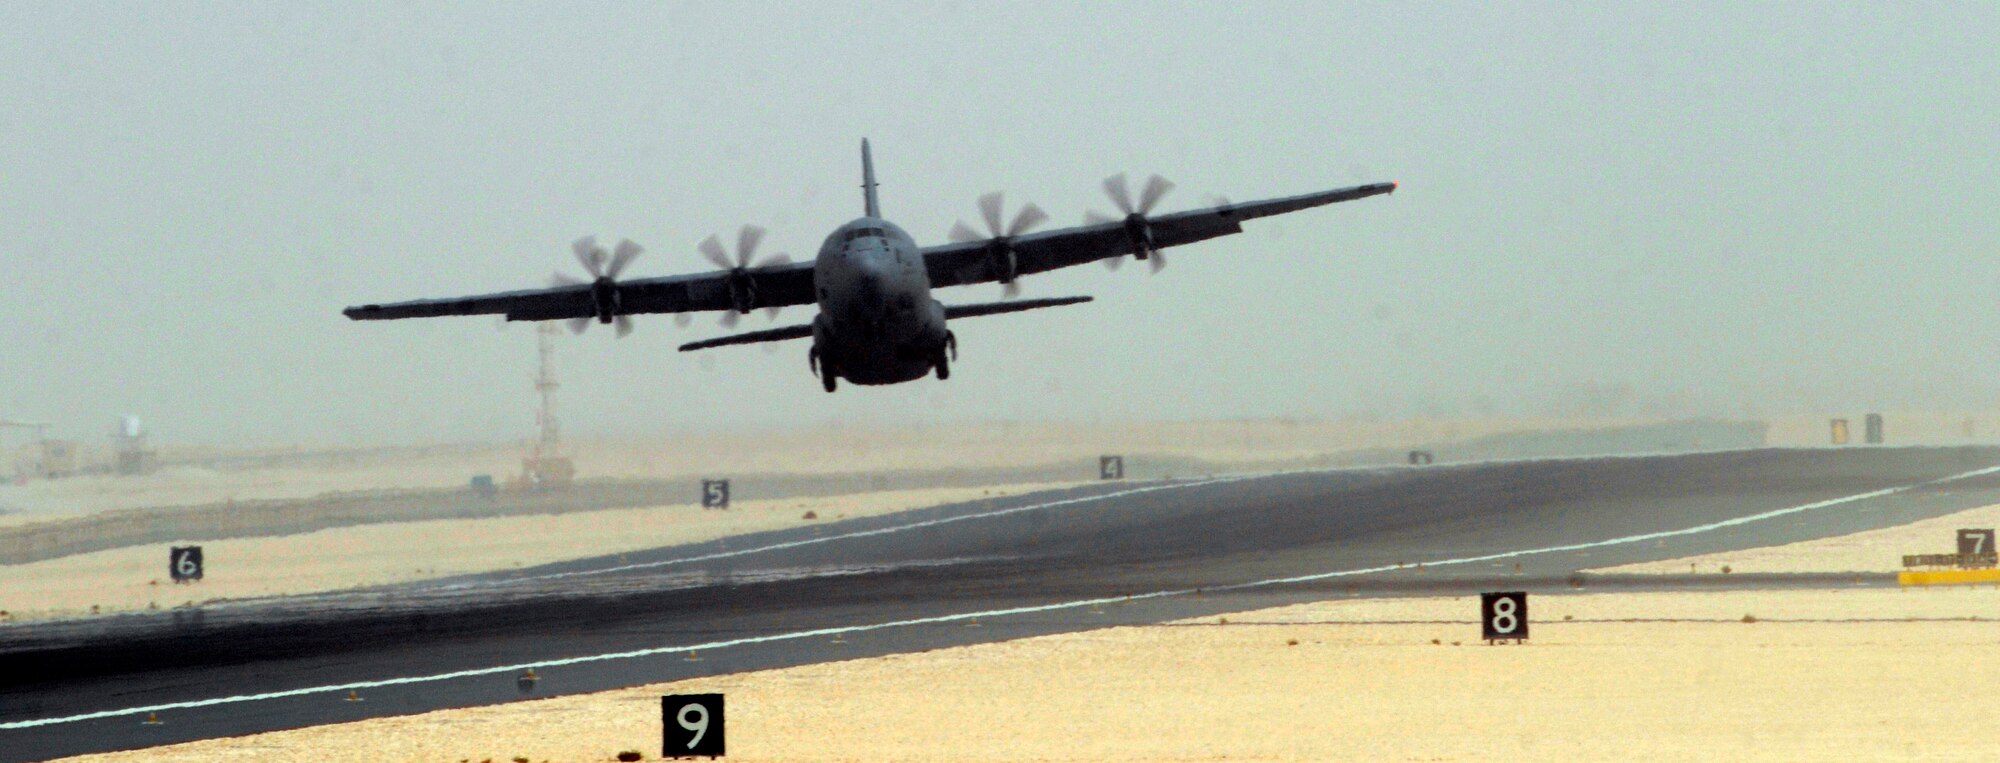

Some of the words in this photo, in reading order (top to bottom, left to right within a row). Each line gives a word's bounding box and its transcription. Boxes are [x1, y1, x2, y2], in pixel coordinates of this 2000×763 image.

[709, 483, 723, 504] 5
[1965, 533, 1986, 554] 7
[178, 551, 197, 575] 6
[1492, 596, 1517, 634] 8
[676, 703, 709, 750] 9
